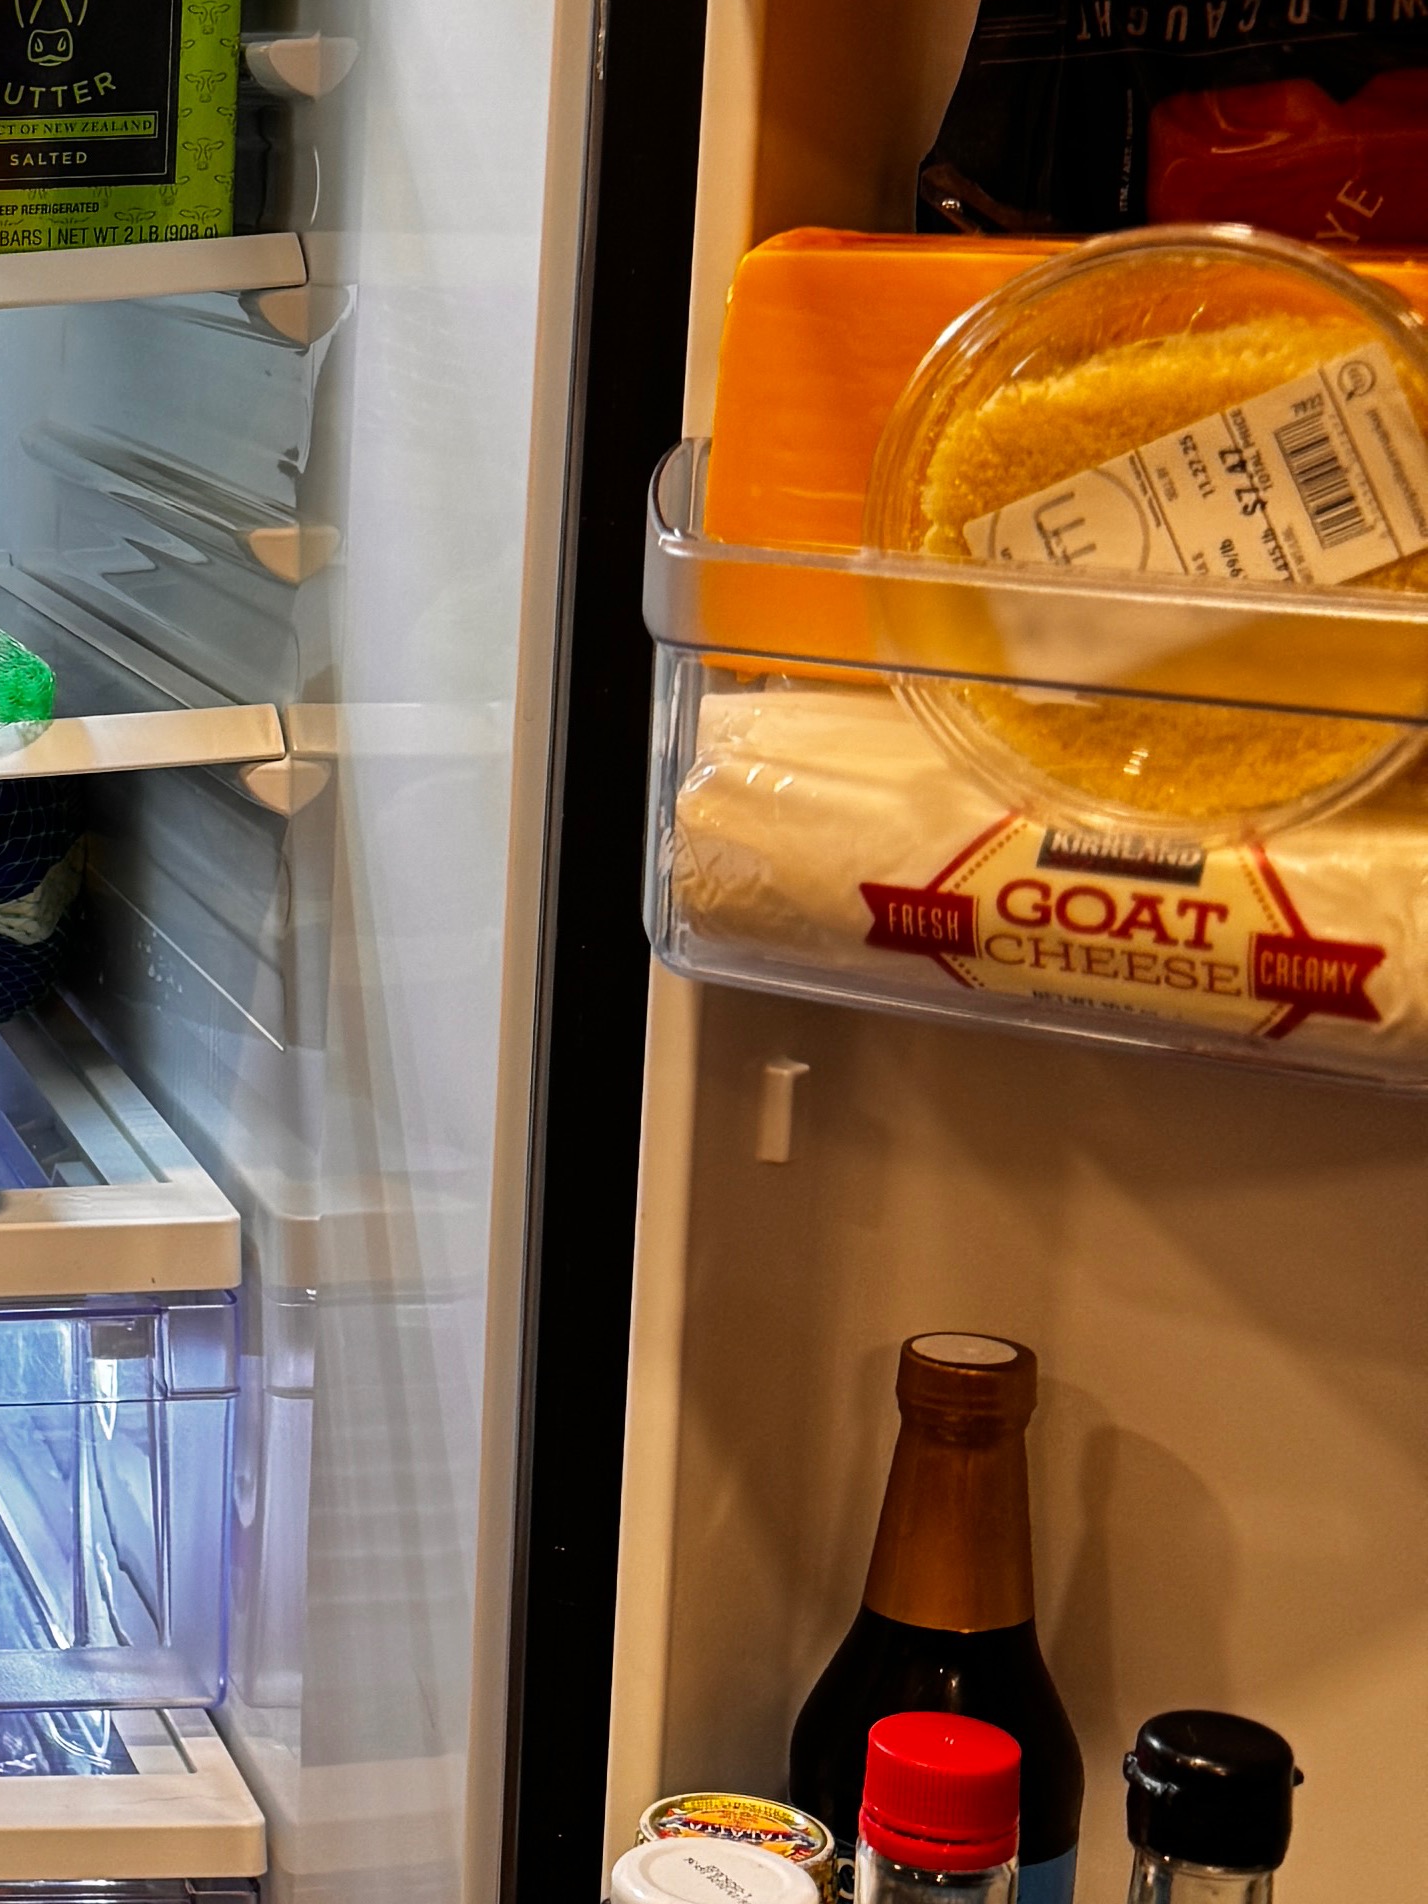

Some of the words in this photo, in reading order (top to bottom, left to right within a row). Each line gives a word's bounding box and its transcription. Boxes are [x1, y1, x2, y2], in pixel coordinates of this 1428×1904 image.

[20, 122, 39, 135] OF
[43, 121, 76, 135] NEW
[80, 118, 152, 133] ZEALAND
[10, 151, 88, 166] SALTED
[20, 201, 100, 216] REFRIGERATED
[0, 229, 43, 248] BARS
[58, 227, 88, 246] NET
[94, 226, 119, 244] WT
[125, 226, 134, 243] 2
[139, 224, 160, 243] LB
[164, 223, 201, 242] (908
[1217, 446, 1269, 517] $7.47
[1052, 830, 1205, 869] KIRKLAND
[888, 902, 959, 942] FRESH
[996, 878, 1229, 951] GOAT
[984, 934, 1243, 998] CHEESE
[1259, 950, 1358, 996] CREAMY
